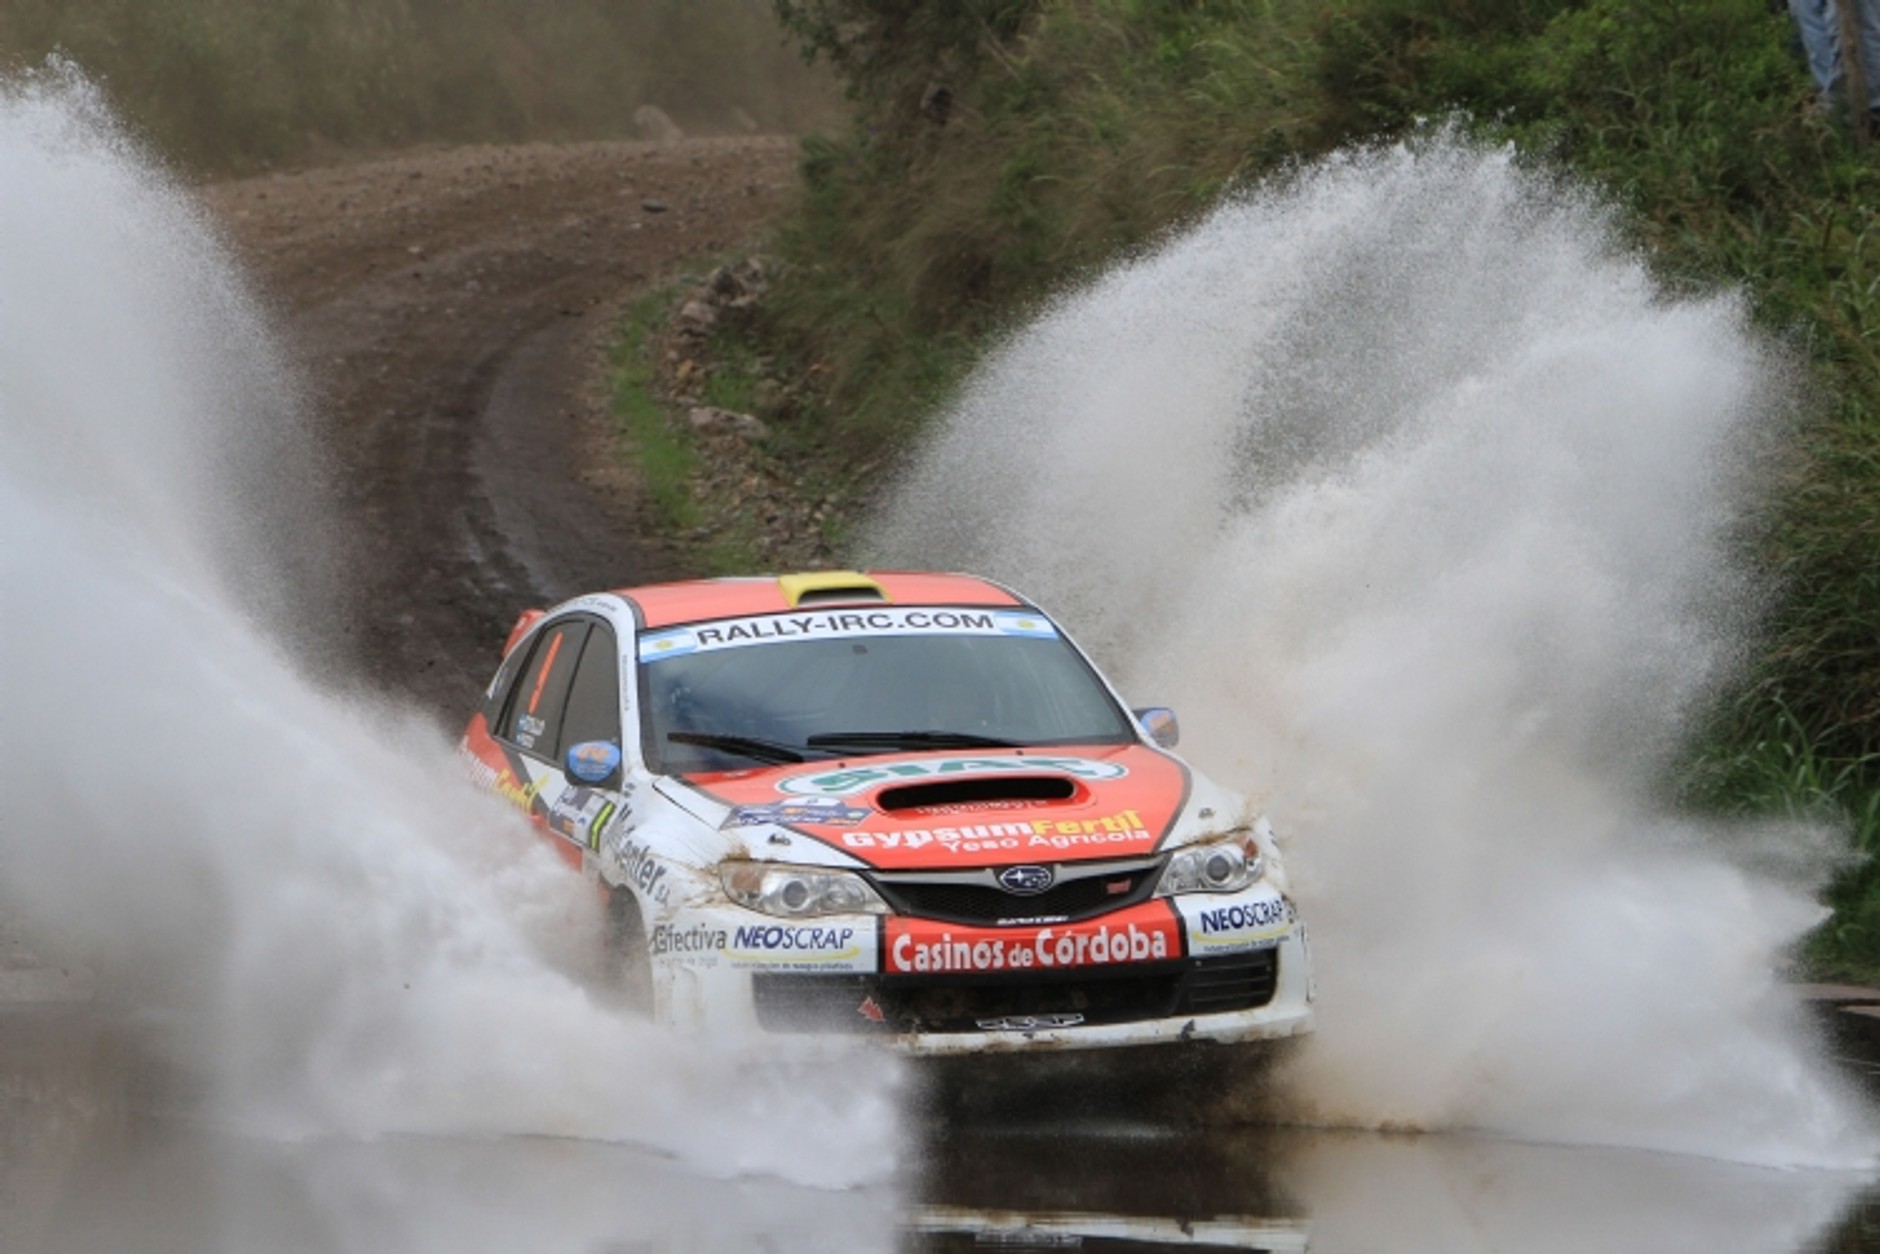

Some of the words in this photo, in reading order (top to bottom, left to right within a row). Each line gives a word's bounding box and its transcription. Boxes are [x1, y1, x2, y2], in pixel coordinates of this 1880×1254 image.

[697, 612, 993, 645] RALLY-IRC.COM
[942, 837, 1020, 854] Yeso
[733, 926, 853, 949] NEOSCRAP
[892, 932, 1005, 973] Casinos
[1007, 943, 1034, 968] de
[1035, 924, 1168, 967] Córdoba
